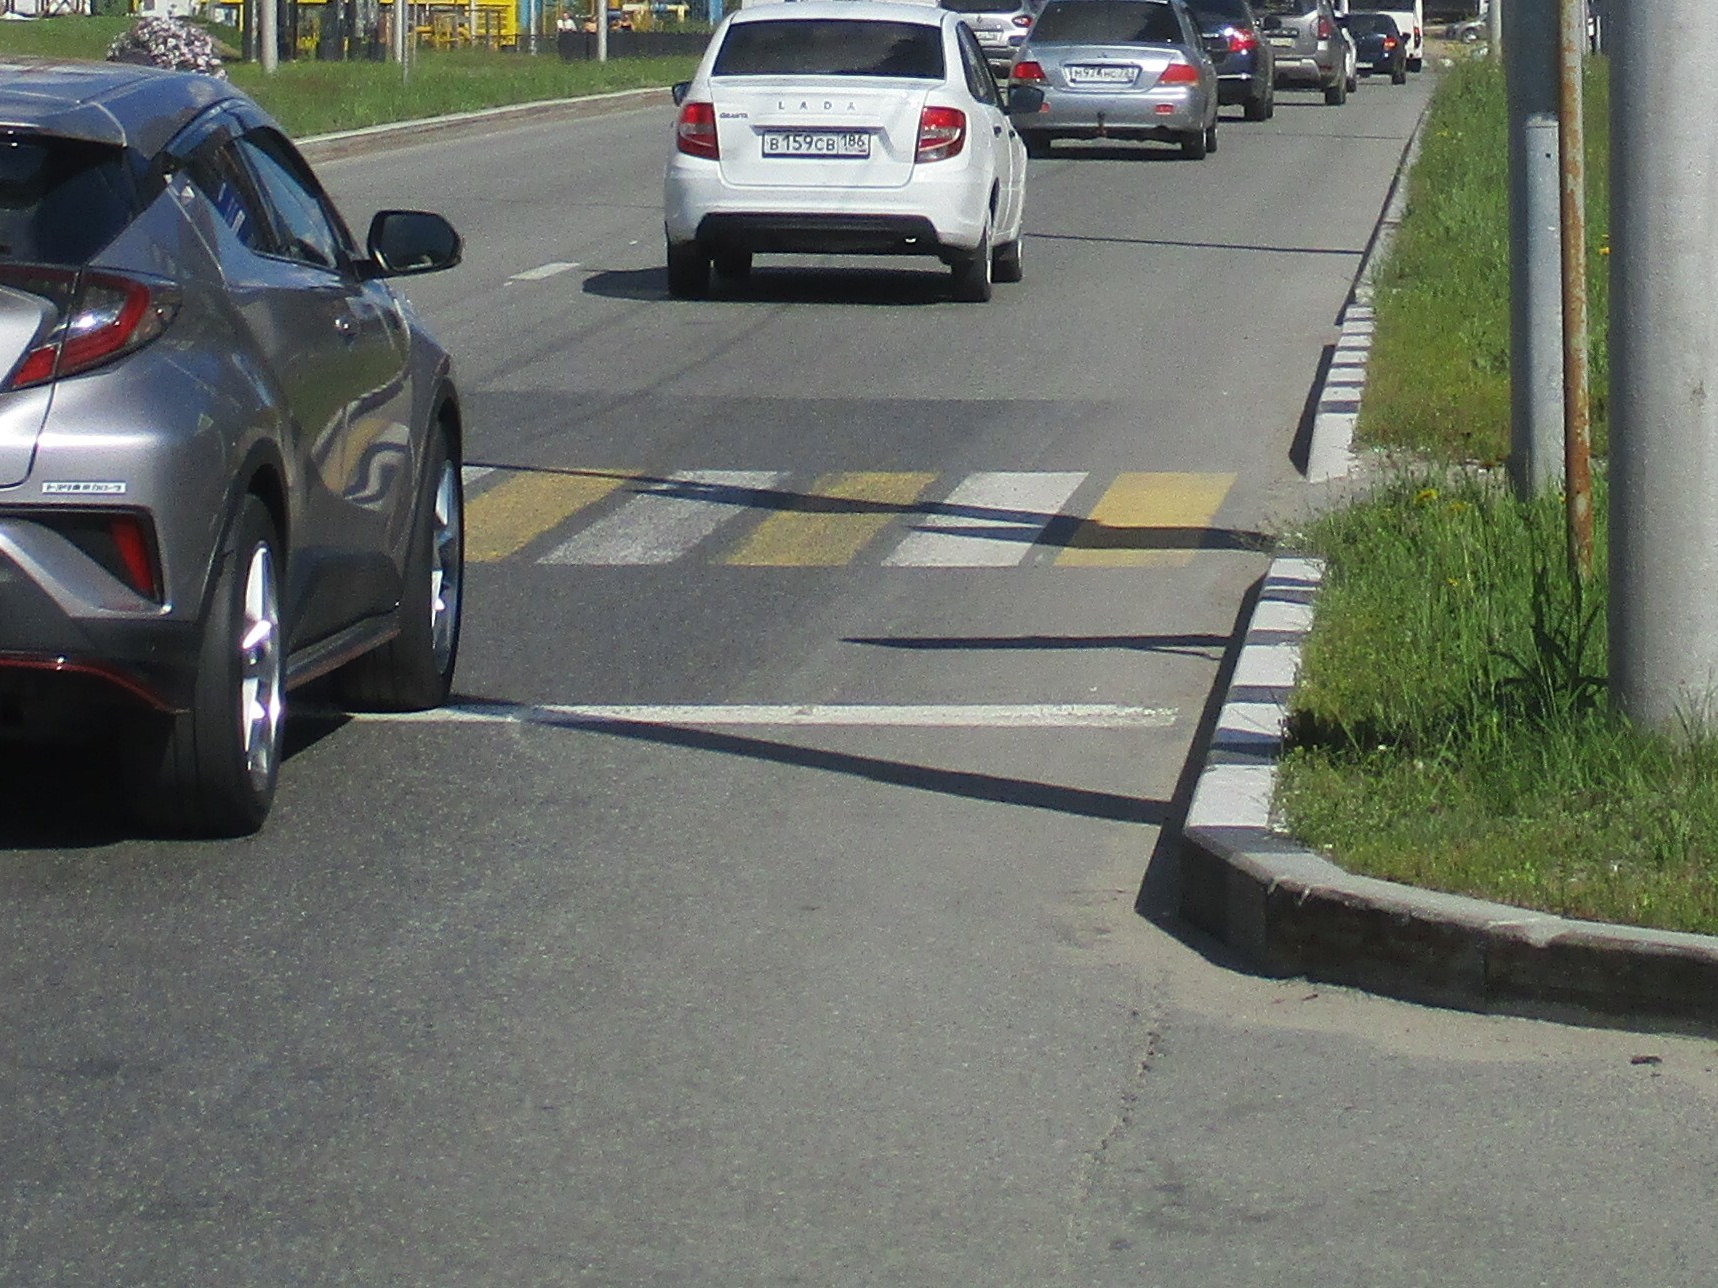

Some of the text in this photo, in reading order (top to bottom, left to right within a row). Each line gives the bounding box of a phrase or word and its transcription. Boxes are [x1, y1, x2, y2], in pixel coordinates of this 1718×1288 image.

[778, 101, 856, 110] LADA
[769, 135, 866, 152] В159СВ 186
